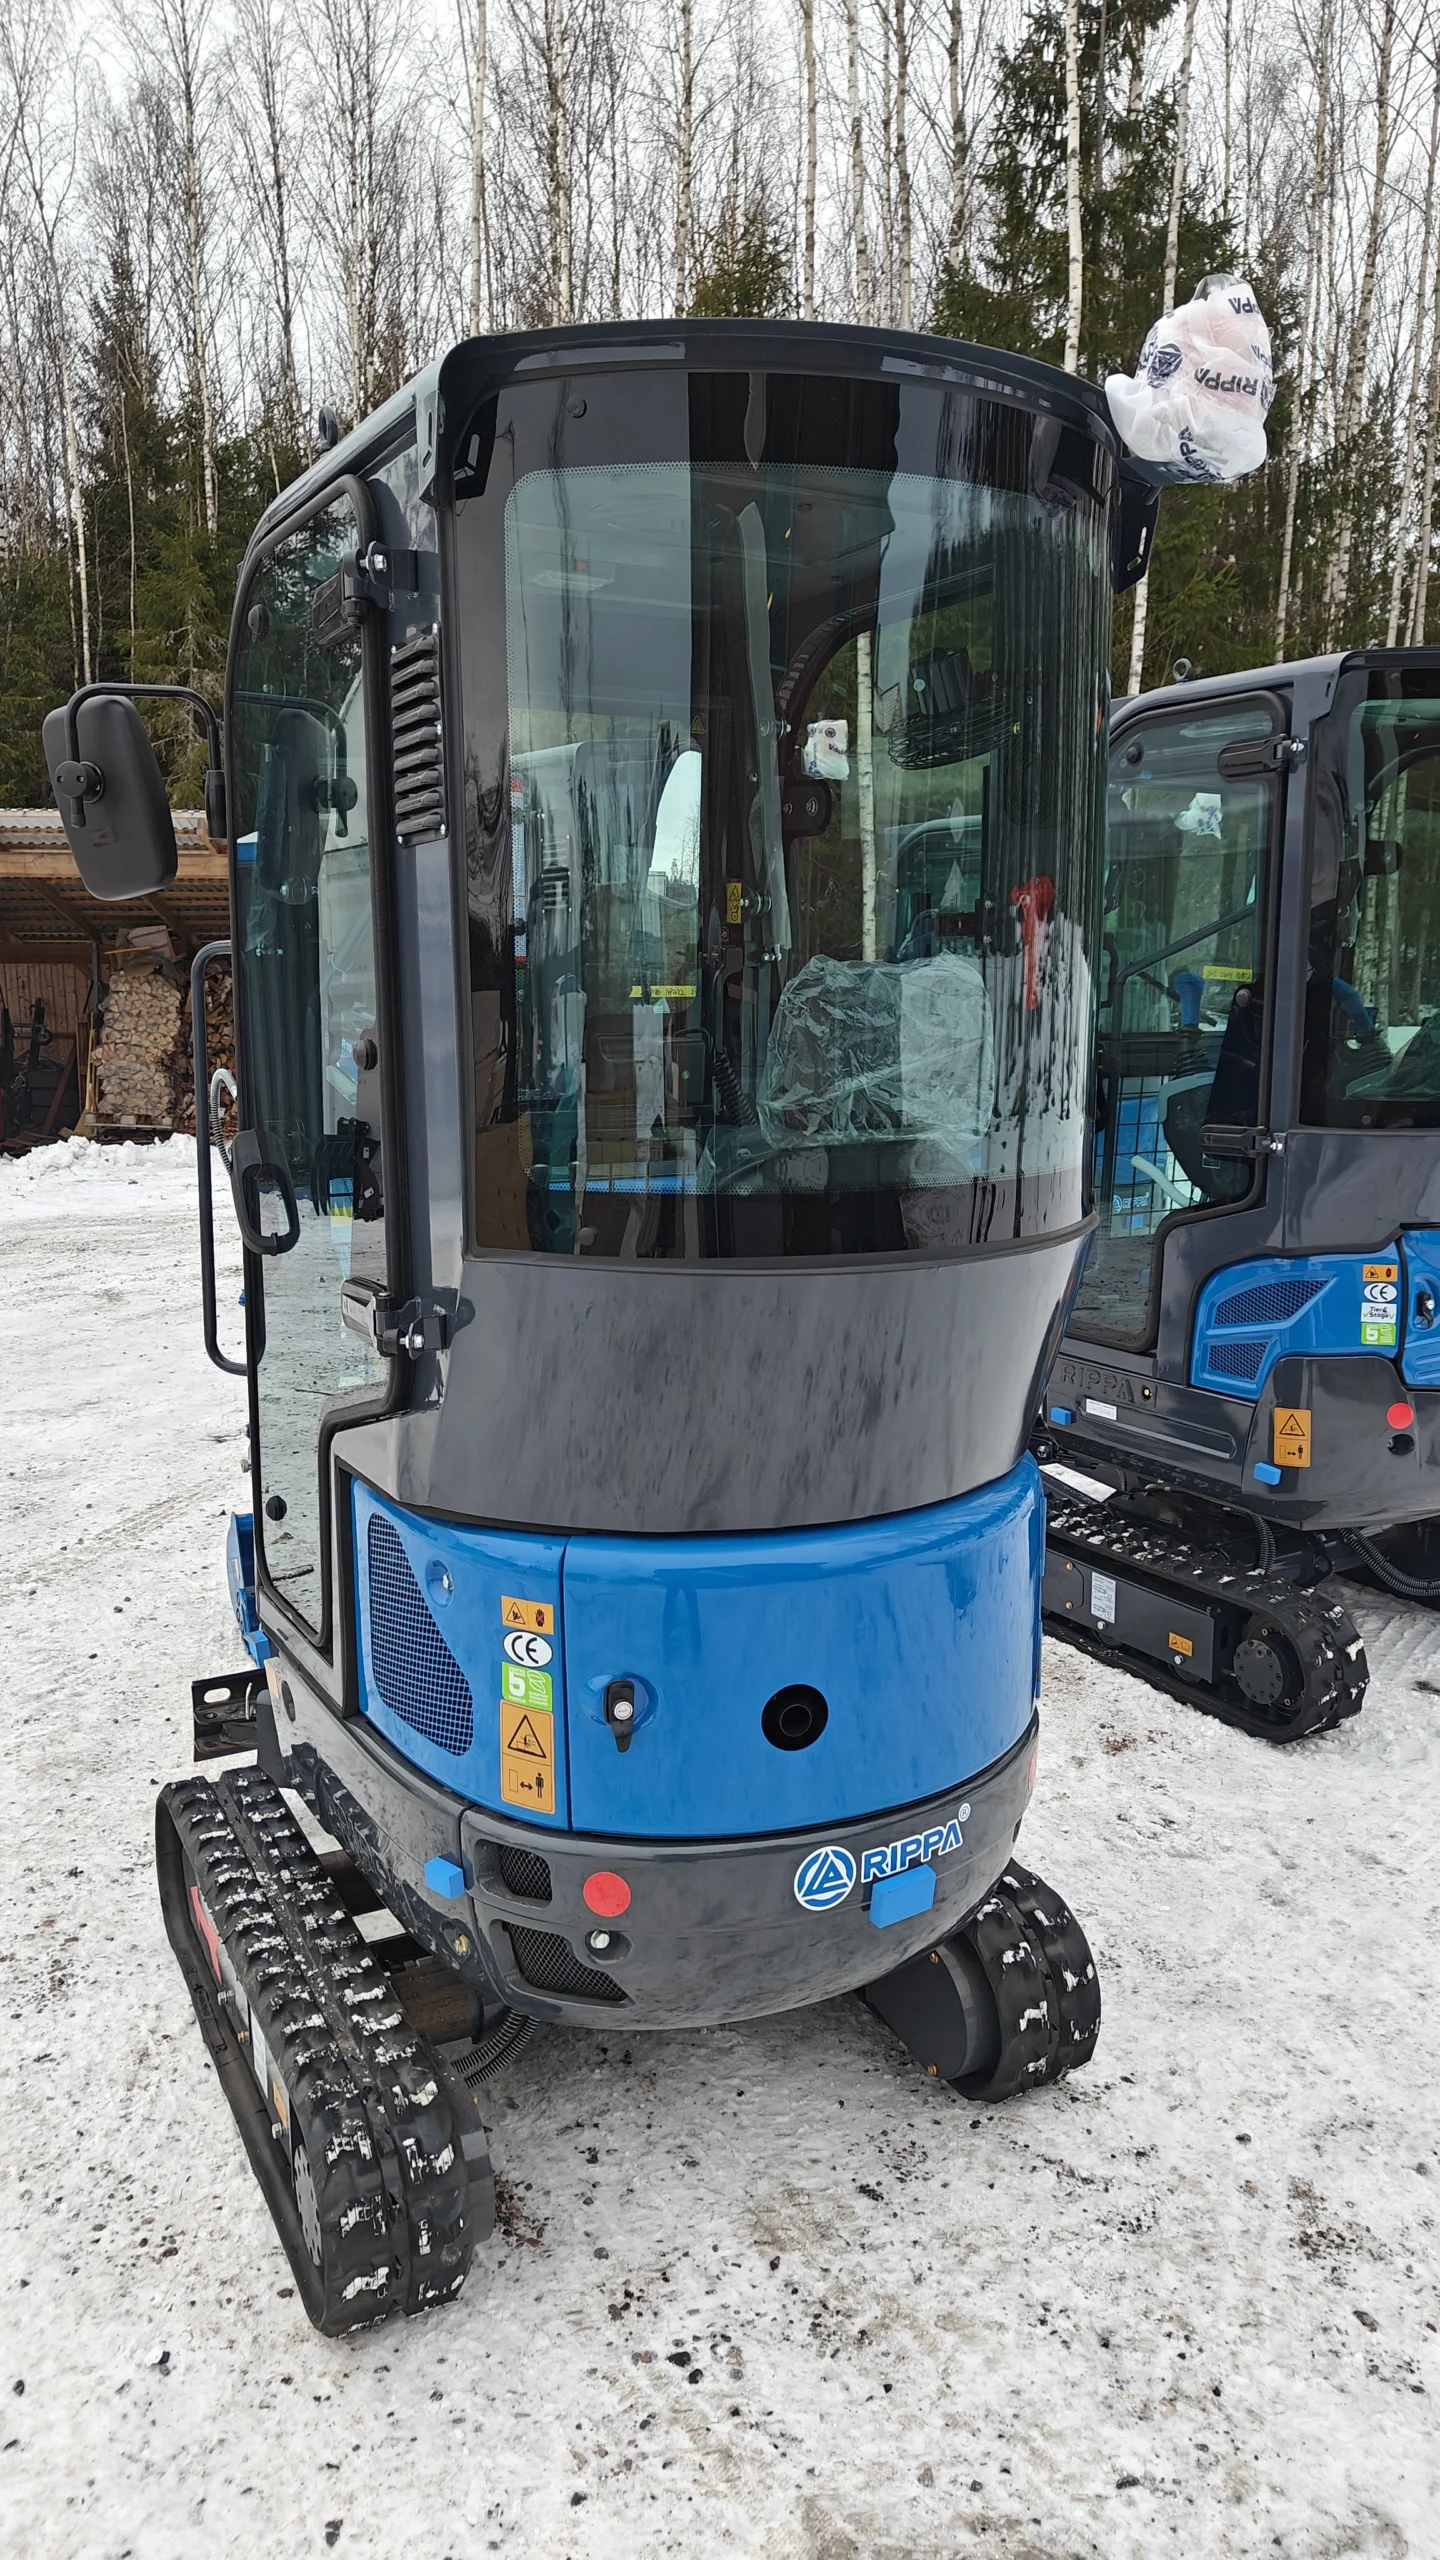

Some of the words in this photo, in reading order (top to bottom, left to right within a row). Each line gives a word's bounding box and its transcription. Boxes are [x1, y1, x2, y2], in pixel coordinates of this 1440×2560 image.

[1194, 368, 1258, 396] RIPPA
[1370, 1285, 1388, 1300] CE
[1061, 1363, 1135, 1404] RIPPA
[511, 1635, 539, 1664] CE
